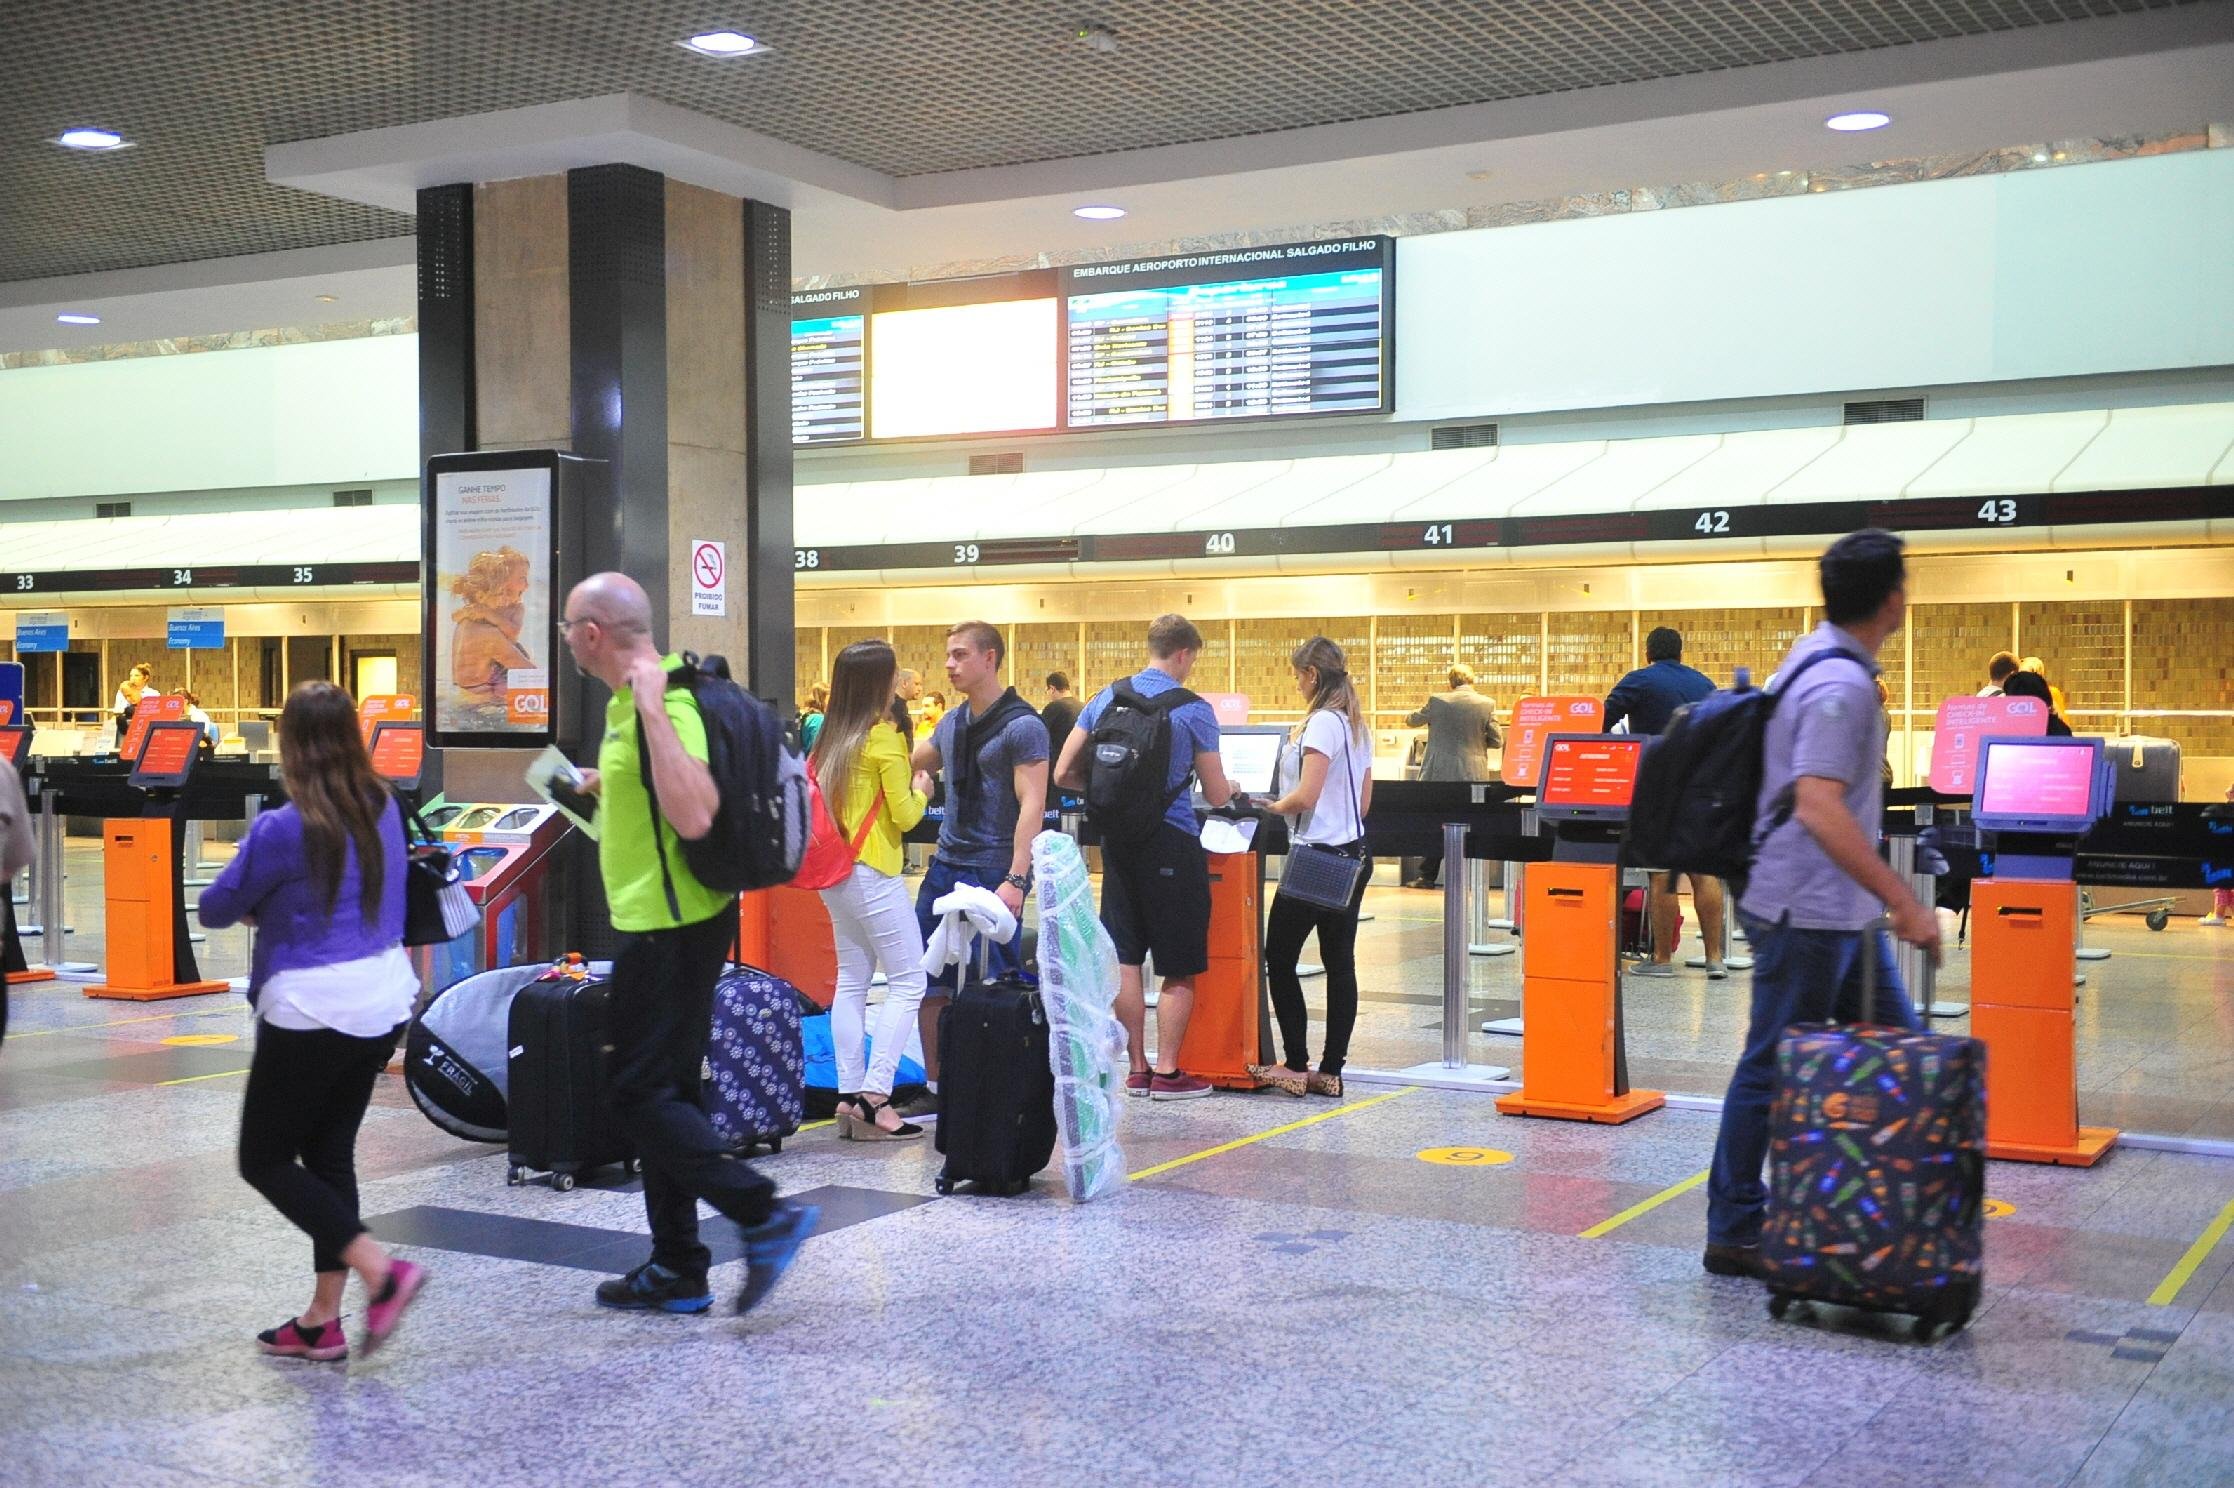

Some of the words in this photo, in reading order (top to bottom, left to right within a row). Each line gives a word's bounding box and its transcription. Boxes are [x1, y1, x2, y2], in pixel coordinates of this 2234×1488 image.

[1073, 264, 1130, 278] EMBARQUE
[1132, 258, 1197, 273] AEROPORTO
[1198, 249, 1285, 266] INTERNACIONAL
[1286, 242, 1341, 258] SALGADO
[1342, 240, 1376, 252] FILHO
[832, 289, 860, 300] FILHO
[458, 486, 480, 494] GANHE
[482, 484, 506, 493] TEMPO
[1977, 500, 2017, 522] 43
[1695, 511, 1730, 533] 42
[1424, 525, 1452, 544] 41
[1206, 533, 1235, 553] 40
[795, 550, 819, 568] 38
[954, 544, 980, 563] 39
[17, 575, 34, 590] 33
[174, 569, 192, 585] 34
[293, 567, 313, 583] 35
[694, 592, 722, 601] PROIBIDO
[698, 602, 719, 610] FUMAR
[514, 694, 548, 713] GOL
[1569, 702, 1595, 713] GOL
[2006, 702, 2037, 714] GOL
[2150, 805, 2174, 815] belt
